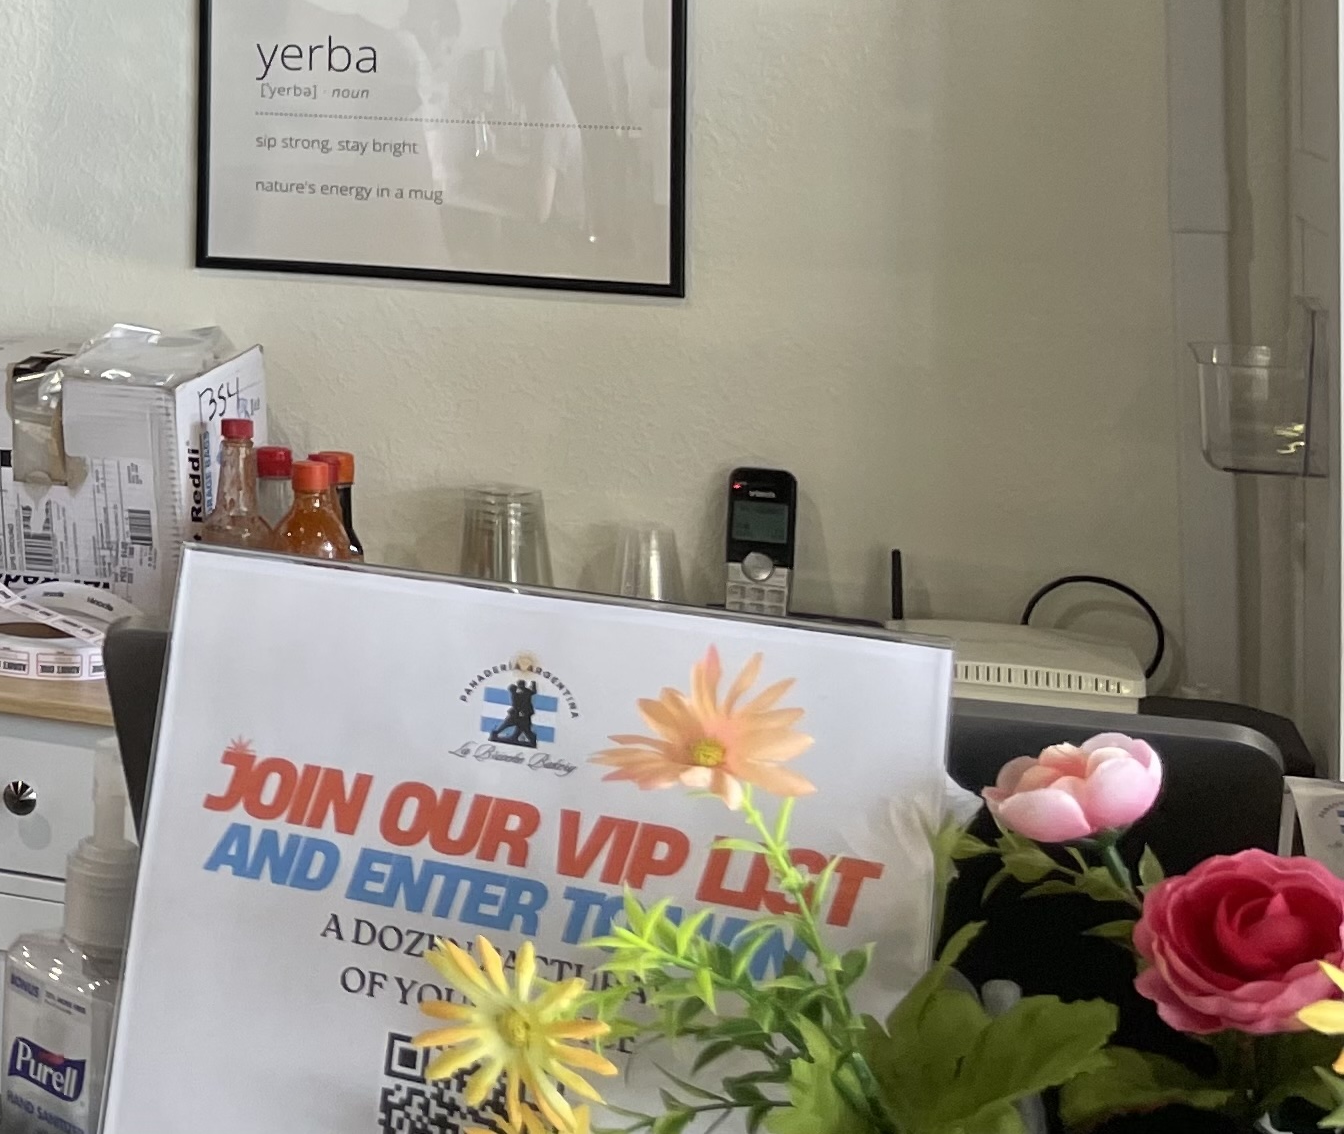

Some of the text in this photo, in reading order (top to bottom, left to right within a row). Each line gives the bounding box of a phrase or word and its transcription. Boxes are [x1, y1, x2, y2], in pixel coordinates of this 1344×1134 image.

[255, 35, 379, 80] yerba
[332, 87, 370, 100] noun
[255, 134, 420, 156] sip strong, stay bright
[255, 178, 444, 205] nature's energy in a mug
[187, 448, 203, 523] Reddi
[204, 750, 374, 837] JOIN
[379, 780, 541, 868] OUR
[556, 810, 691, 889] VIP
[204, 821, 548, 938] AND ENTER
[320, 913, 459, 960] A DOZ
[339, 966, 388, 998] OF
[16, 1040, 78, 1100] Purell
